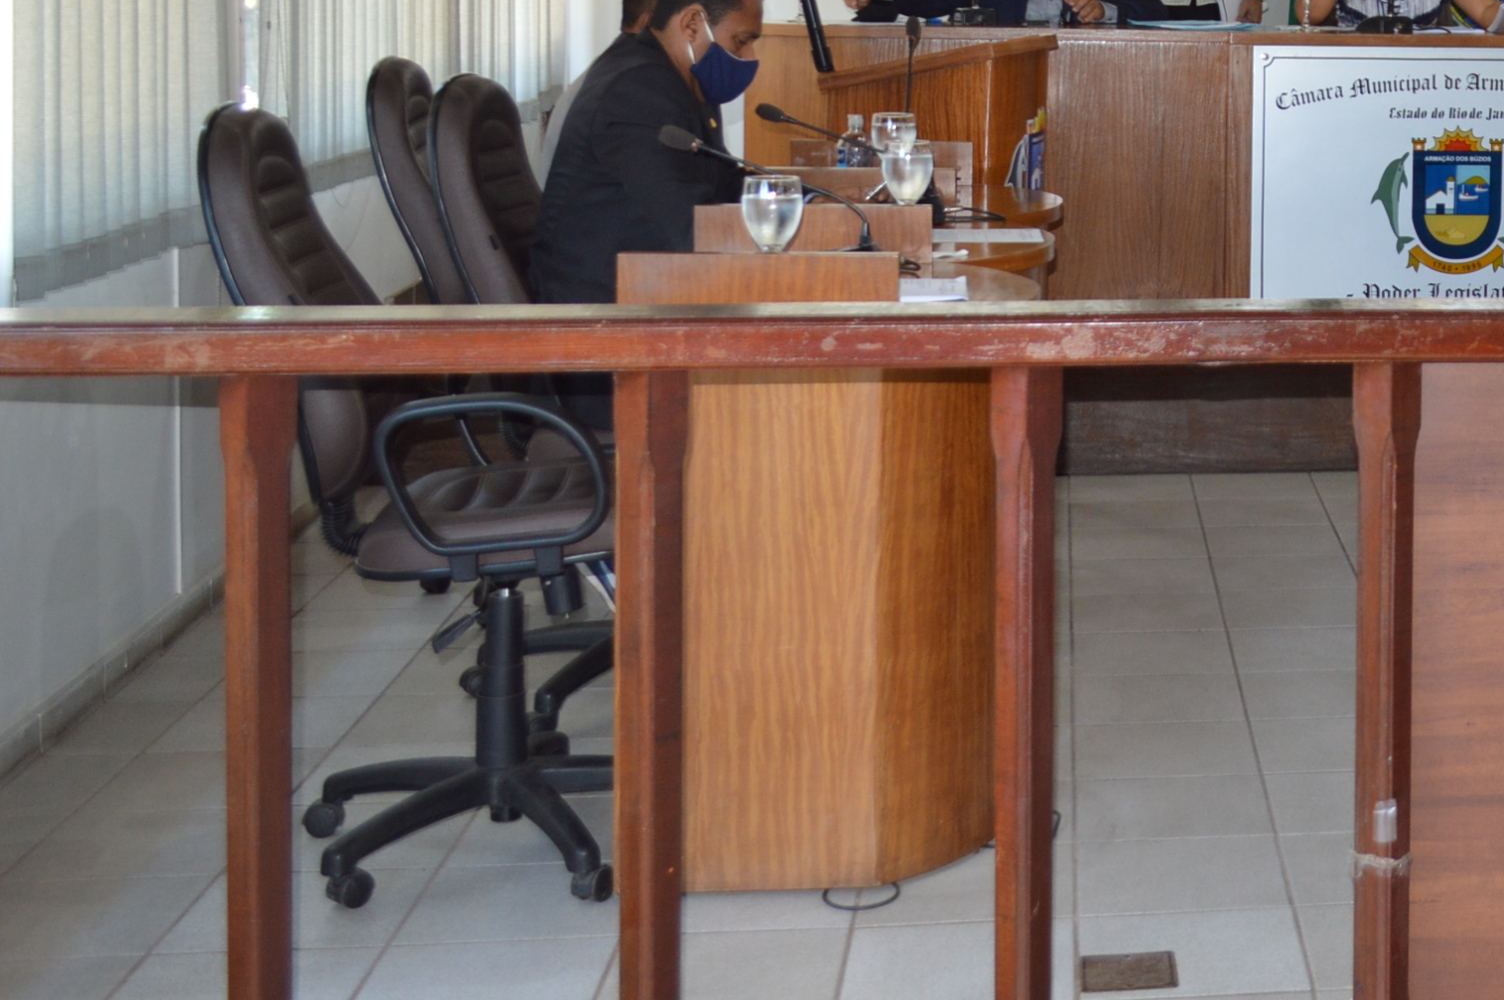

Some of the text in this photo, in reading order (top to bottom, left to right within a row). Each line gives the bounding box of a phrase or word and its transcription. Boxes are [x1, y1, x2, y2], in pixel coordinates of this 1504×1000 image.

[1276, 87, 1343, 110] Câmara
[1350, 73, 1438, 98] Municipal
[1444, 74, 1462, 91] de
[1389, 107, 1428, 119] Estado
[1430, 107, 1445, 119] do
[1424, 155, 1455, 163] ARMAÇÃO
[1433, 261, 1482, 271] 1740 1995
